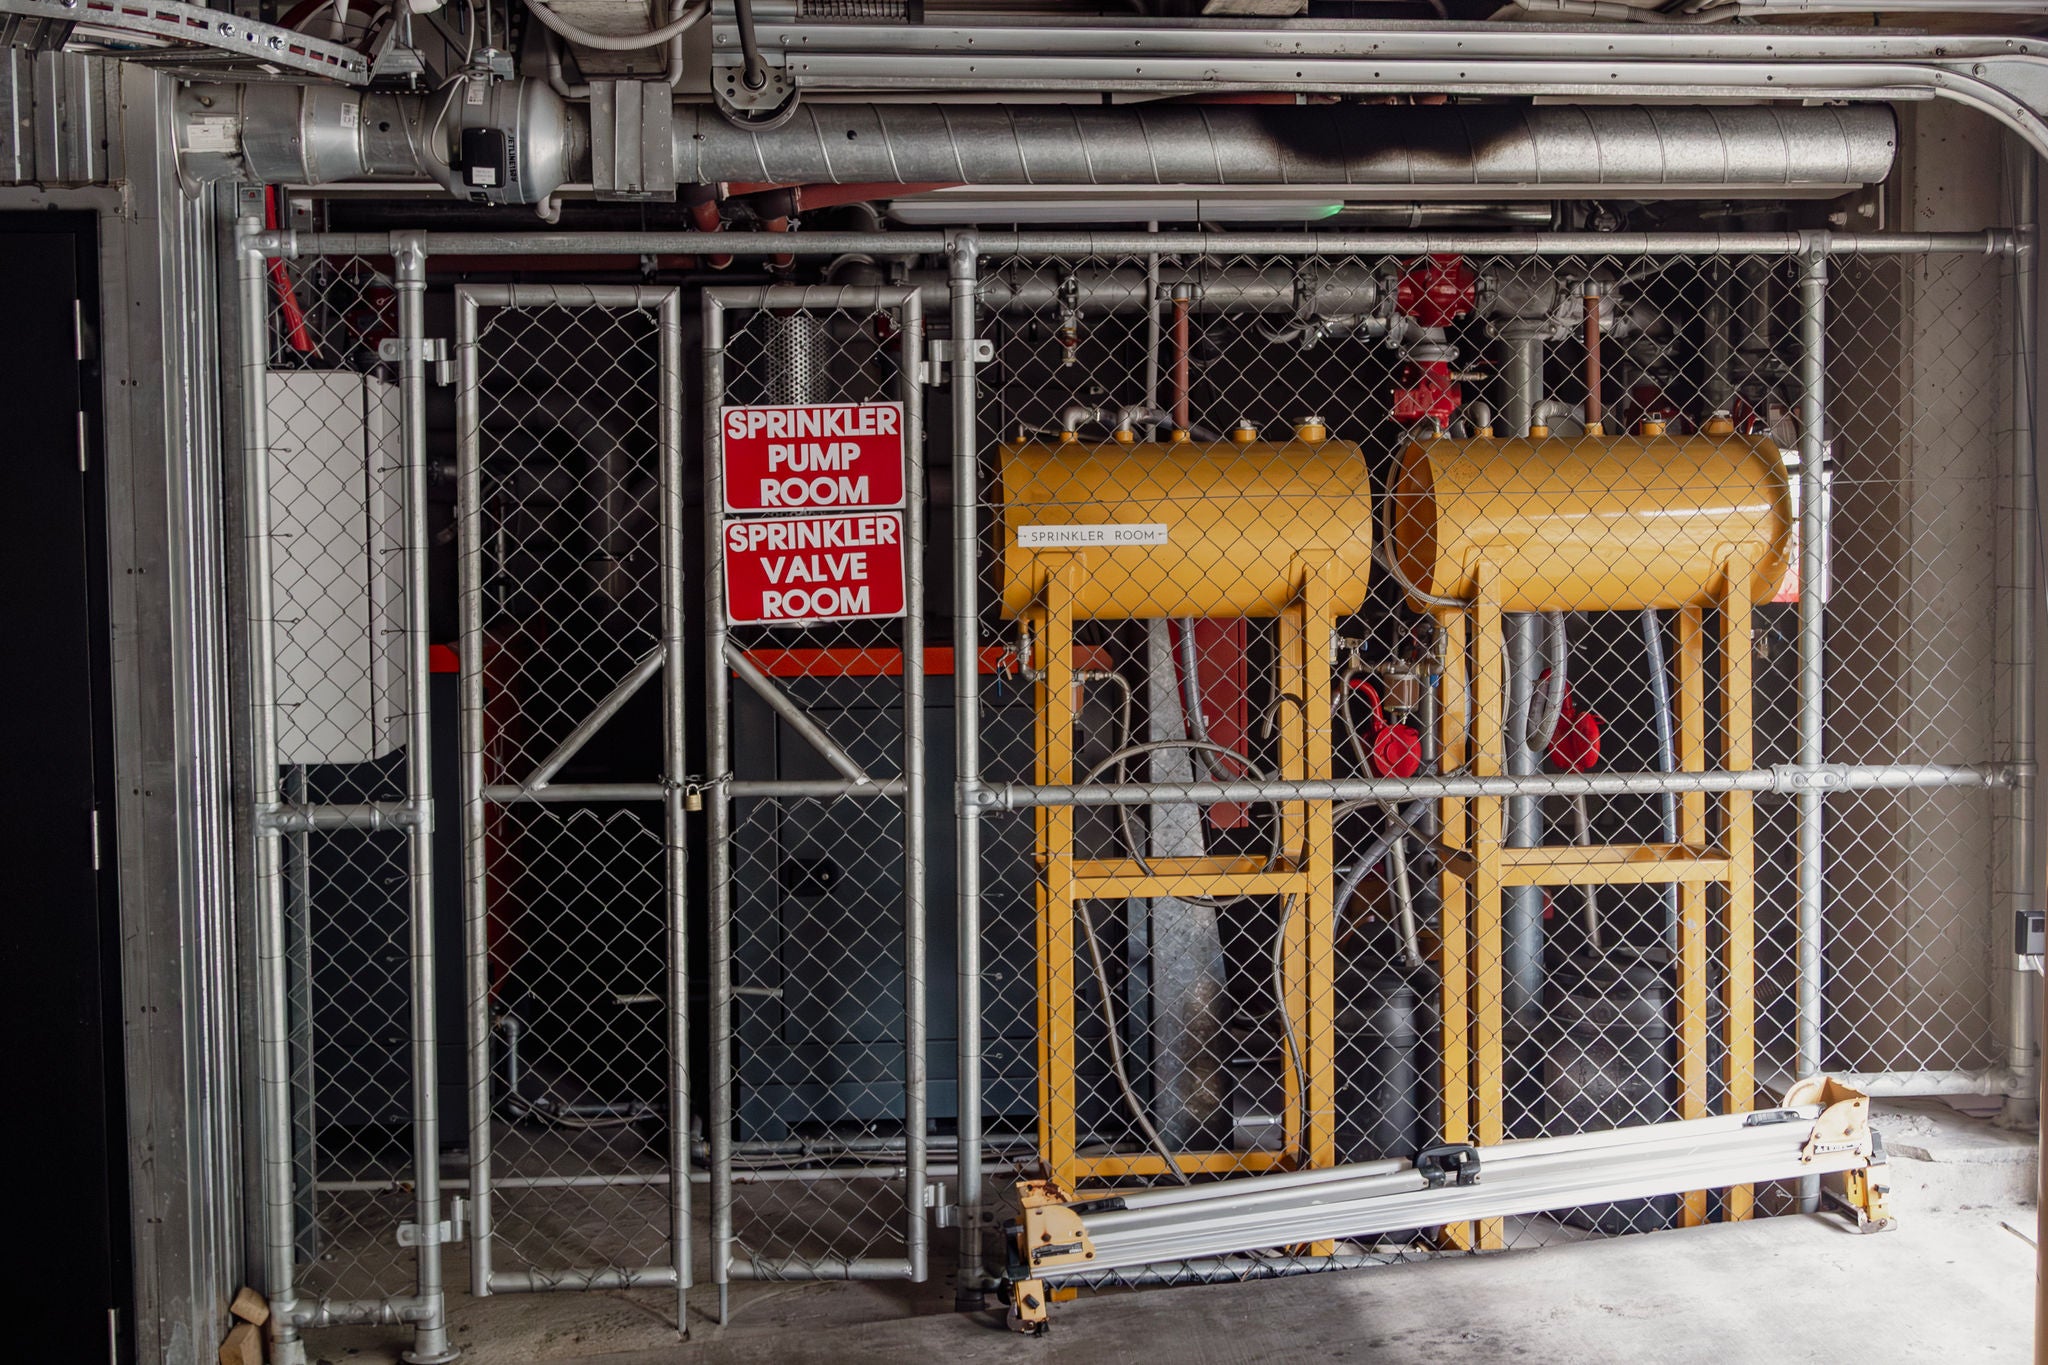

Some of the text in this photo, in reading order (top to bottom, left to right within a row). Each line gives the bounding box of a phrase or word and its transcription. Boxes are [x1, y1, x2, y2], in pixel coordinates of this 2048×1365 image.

[727, 407, 898, 440] SPRINKLER
[768, 442, 861, 473] PUMP
[760, 475, 870, 506] ROOM
[729, 517, 897, 553] SPRINKLER
[1031, 530, 1155, 542] SPRINKLER ROOM
[760, 552, 868, 584] VALVE
[762, 585, 871, 618] ROOM
